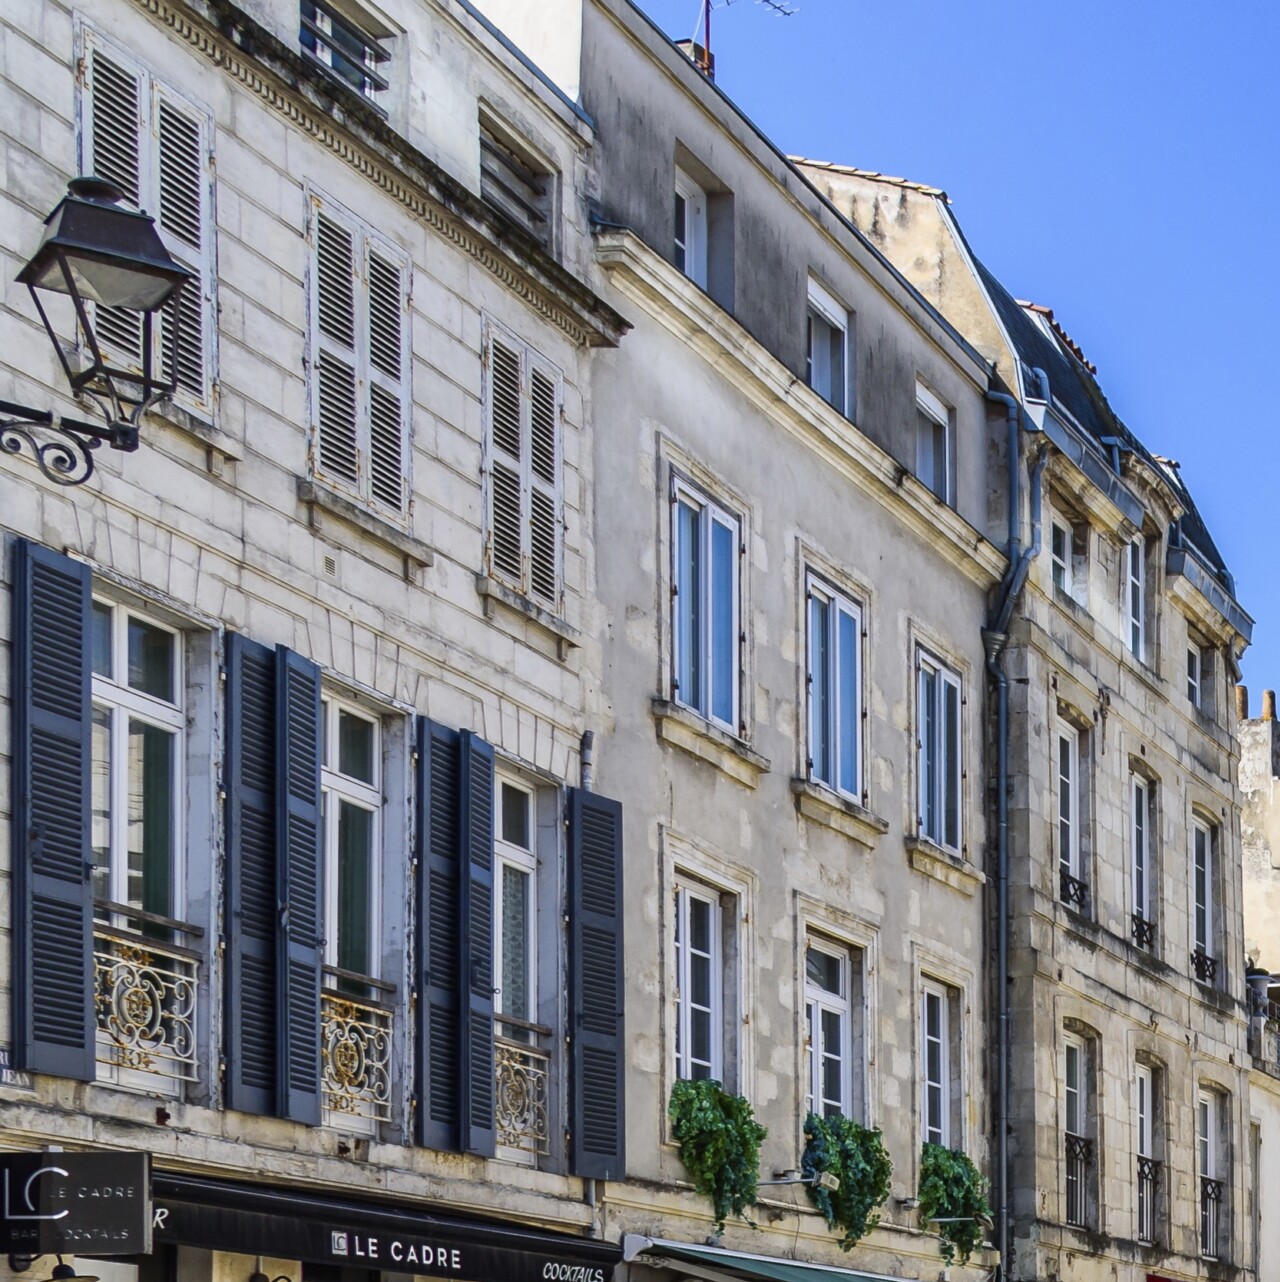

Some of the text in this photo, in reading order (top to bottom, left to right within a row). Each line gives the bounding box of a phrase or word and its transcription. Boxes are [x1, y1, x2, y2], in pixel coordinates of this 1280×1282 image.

[78, 1187, 135, 1198] CADRE
[57, 1229, 129, 1240] OCKTALS
[354, 1235, 378, 1258] LE
[391, 1241, 461, 1269] CADRE
